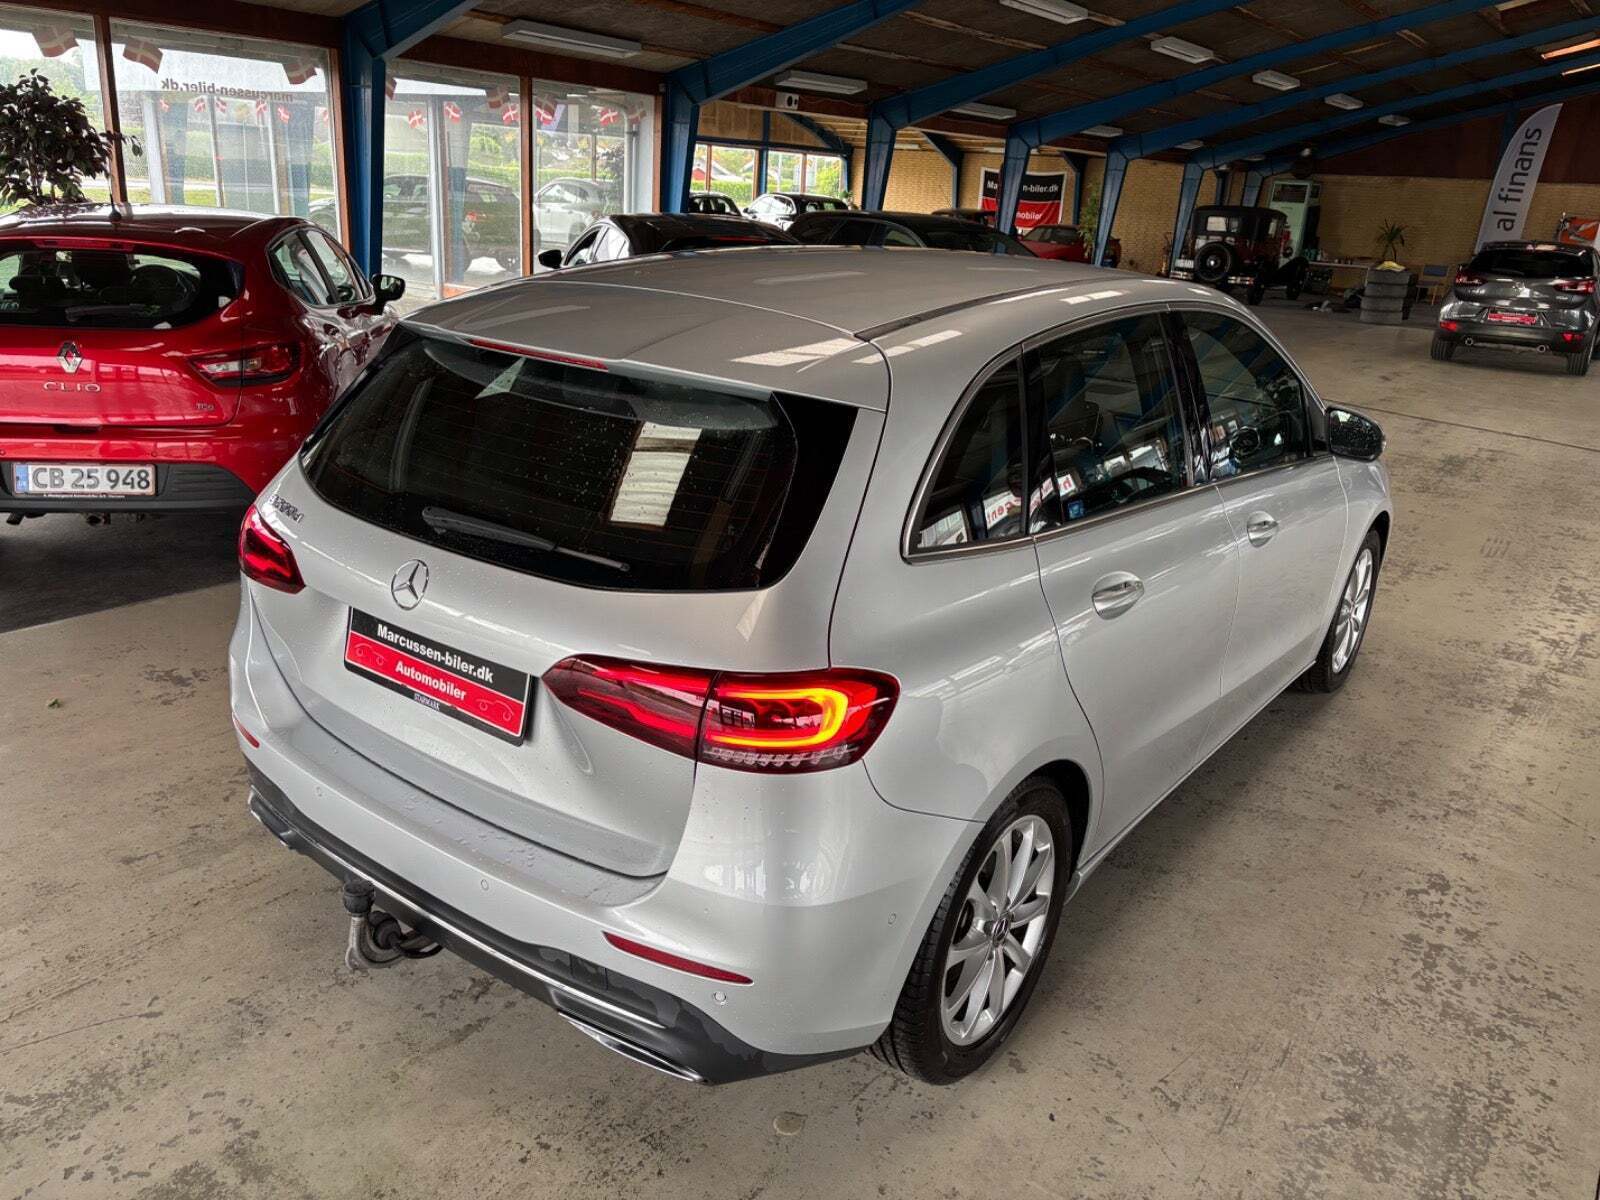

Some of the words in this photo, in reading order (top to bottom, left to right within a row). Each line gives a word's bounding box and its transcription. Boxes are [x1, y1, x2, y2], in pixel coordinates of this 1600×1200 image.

[1498, 127, 1542, 203] finans
[1493, 210, 1517, 231] al
[43, 381, 102, 393] CLIO
[32, 467, 65, 489] CB
[71, 468, 100, 489] 25
[106, 469, 150, 490] 948
[377, 623, 494, 683] Marcussen-biler.dk
[395, 660, 467, 701] Automobiler
